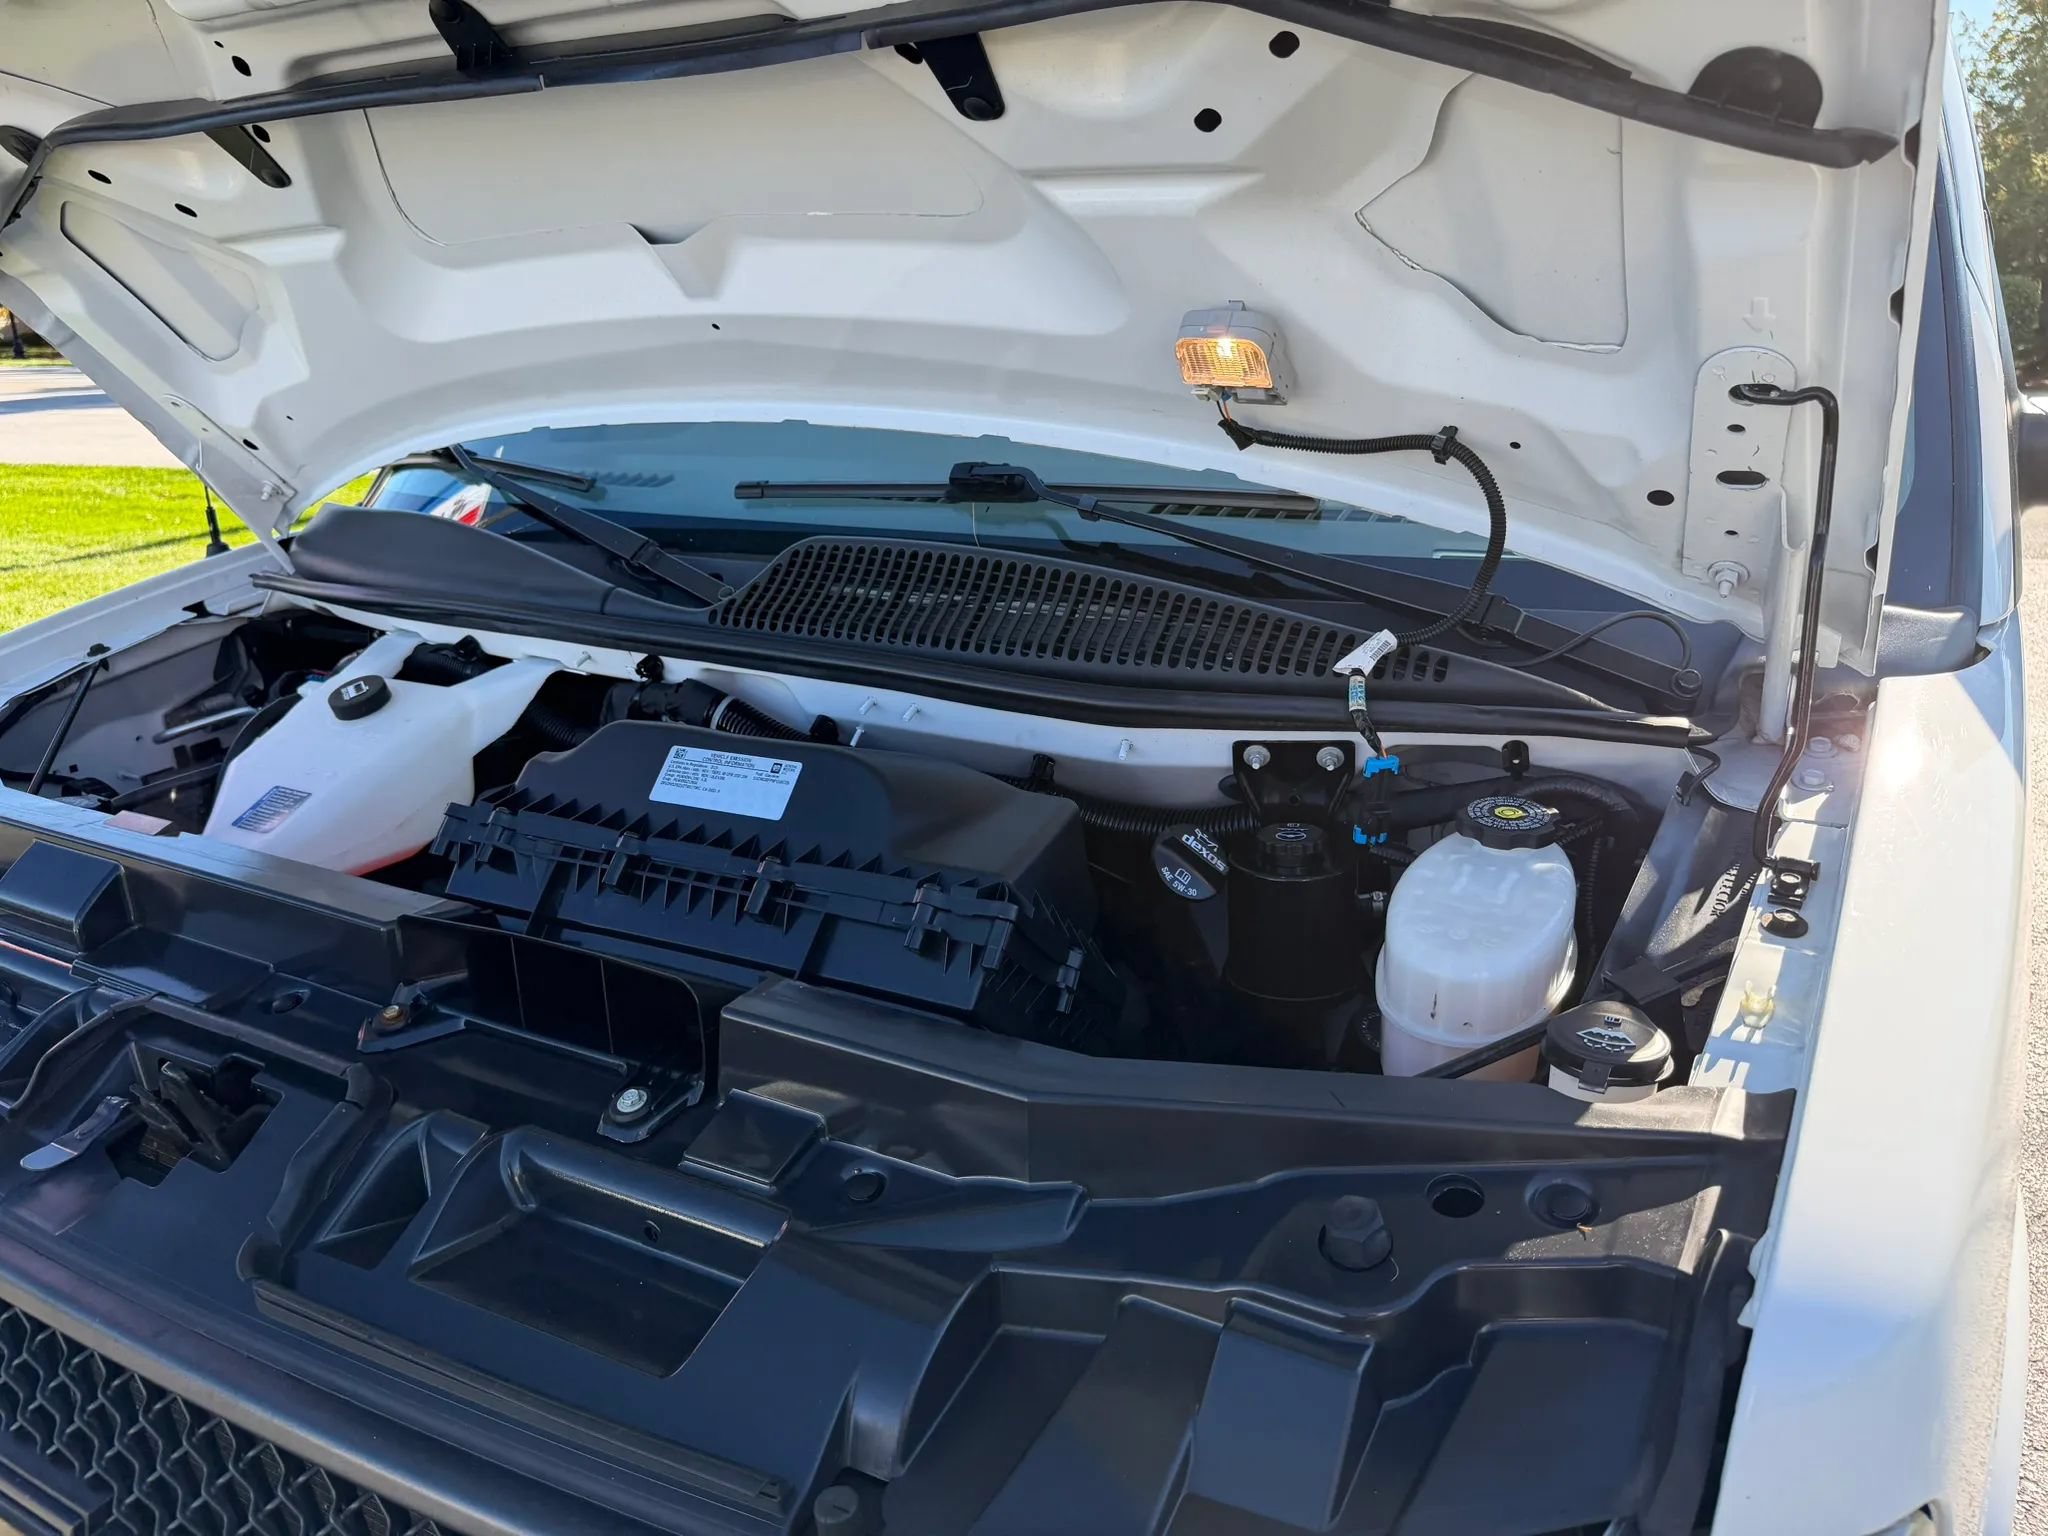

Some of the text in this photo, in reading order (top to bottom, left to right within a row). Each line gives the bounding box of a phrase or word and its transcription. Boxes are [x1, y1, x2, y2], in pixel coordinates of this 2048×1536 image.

[702, 756, 723, 764] CONTROL
[1182, 834, 1226, 871] dexos
[1161, 866, 1197, 897] SAE 5W-30
